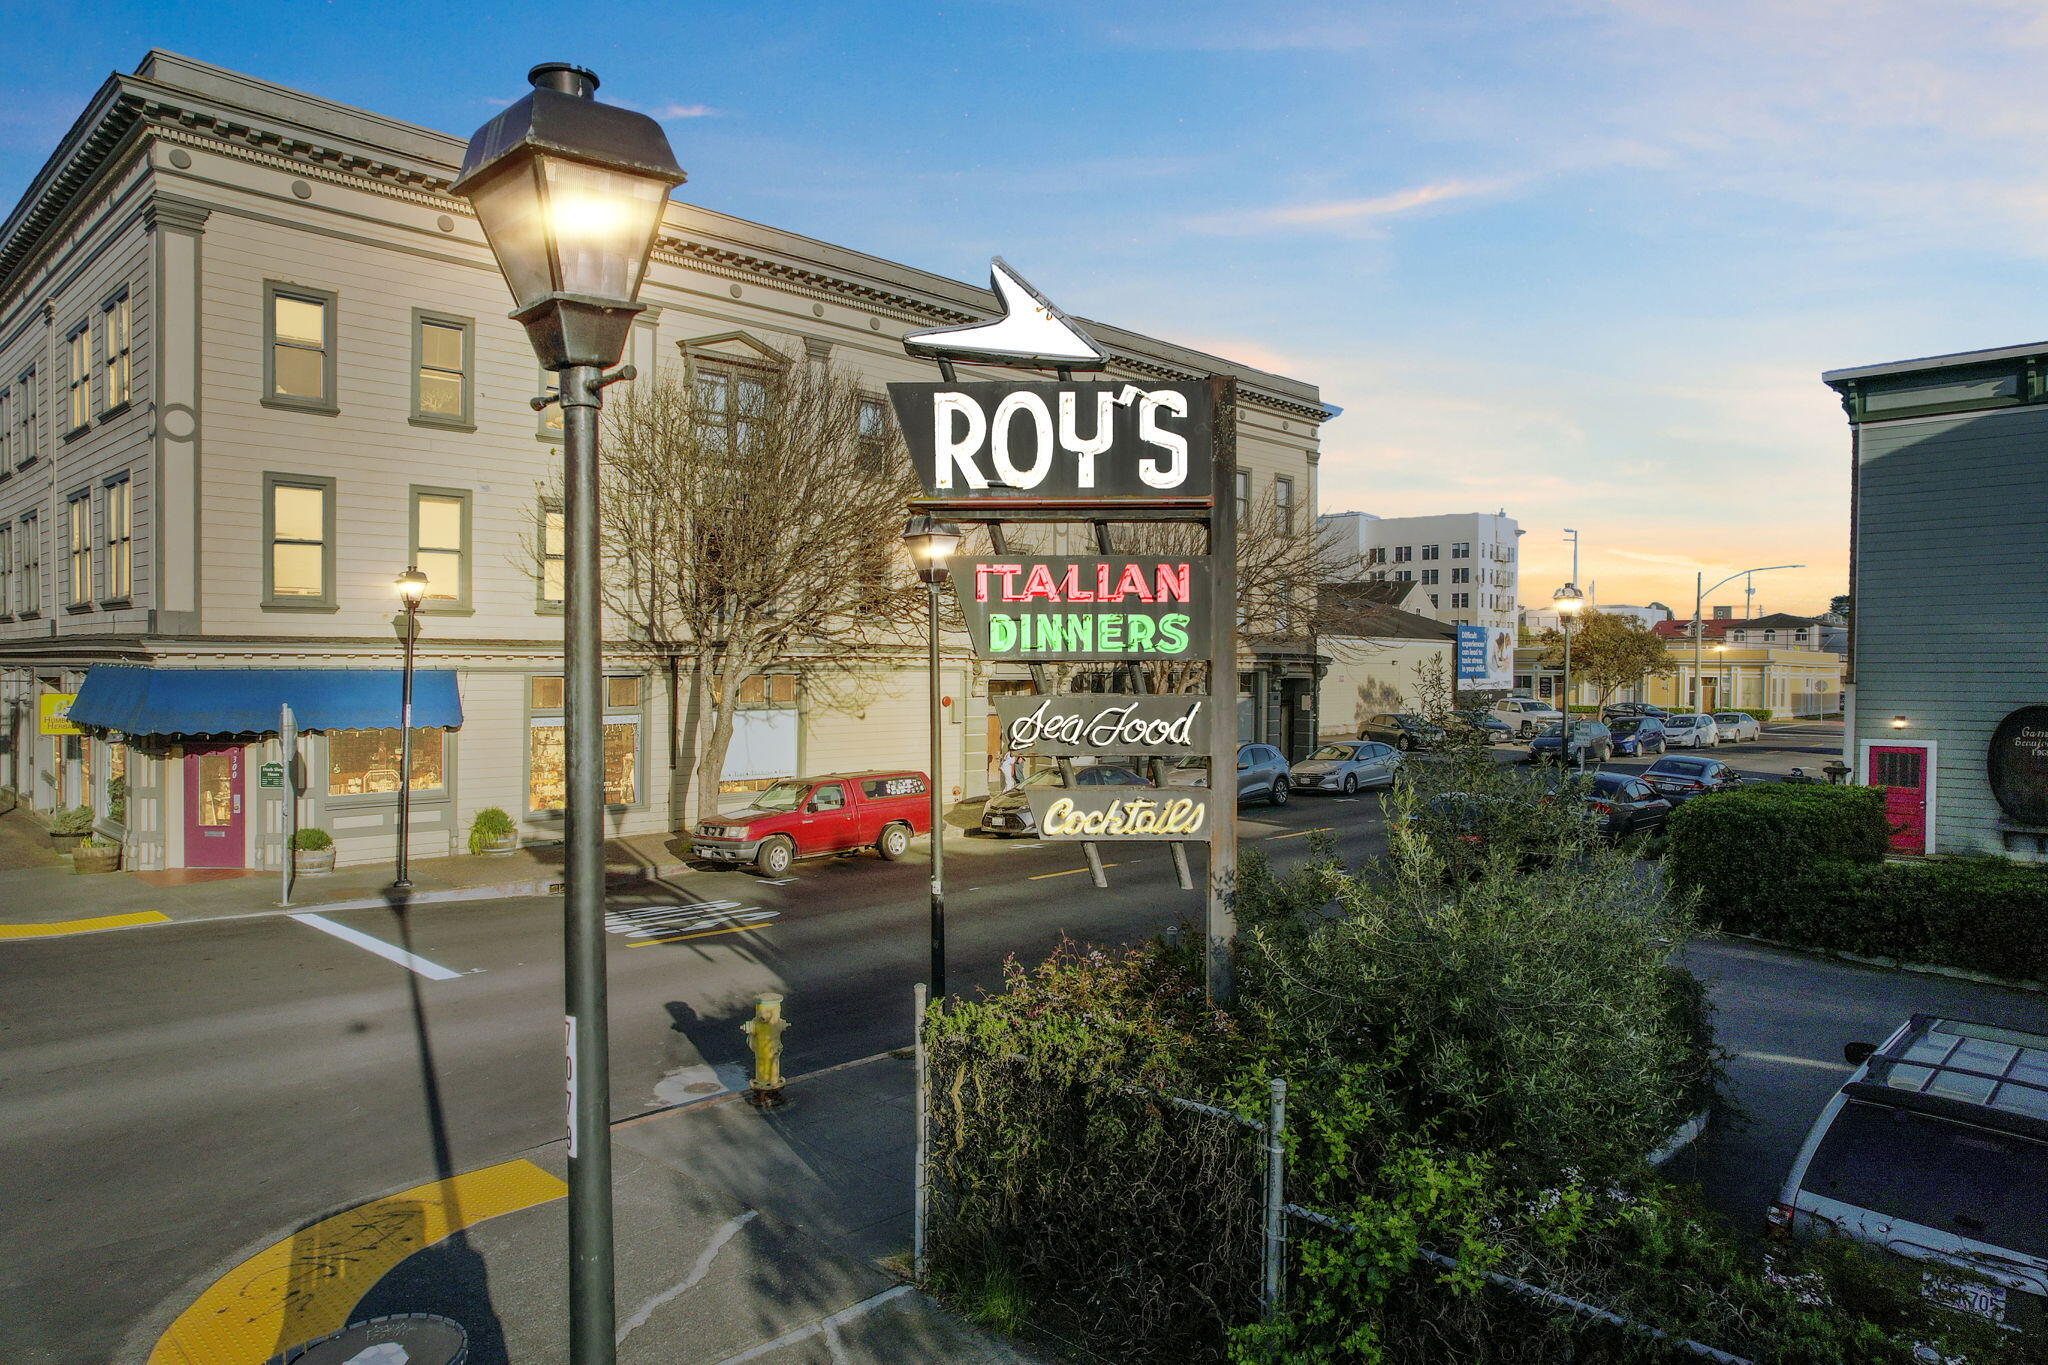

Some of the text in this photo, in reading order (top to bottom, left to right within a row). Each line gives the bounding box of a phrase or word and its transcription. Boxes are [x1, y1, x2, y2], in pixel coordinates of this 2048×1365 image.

[934, 384, 1188, 490] ROY'S
[976, 563, 1190, 603] ITALIAN
[989, 613, 1191, 653] DINNERS
[1466, 666, 1475, 674] your
[1011, 700, 1201, 750] Sea Food
